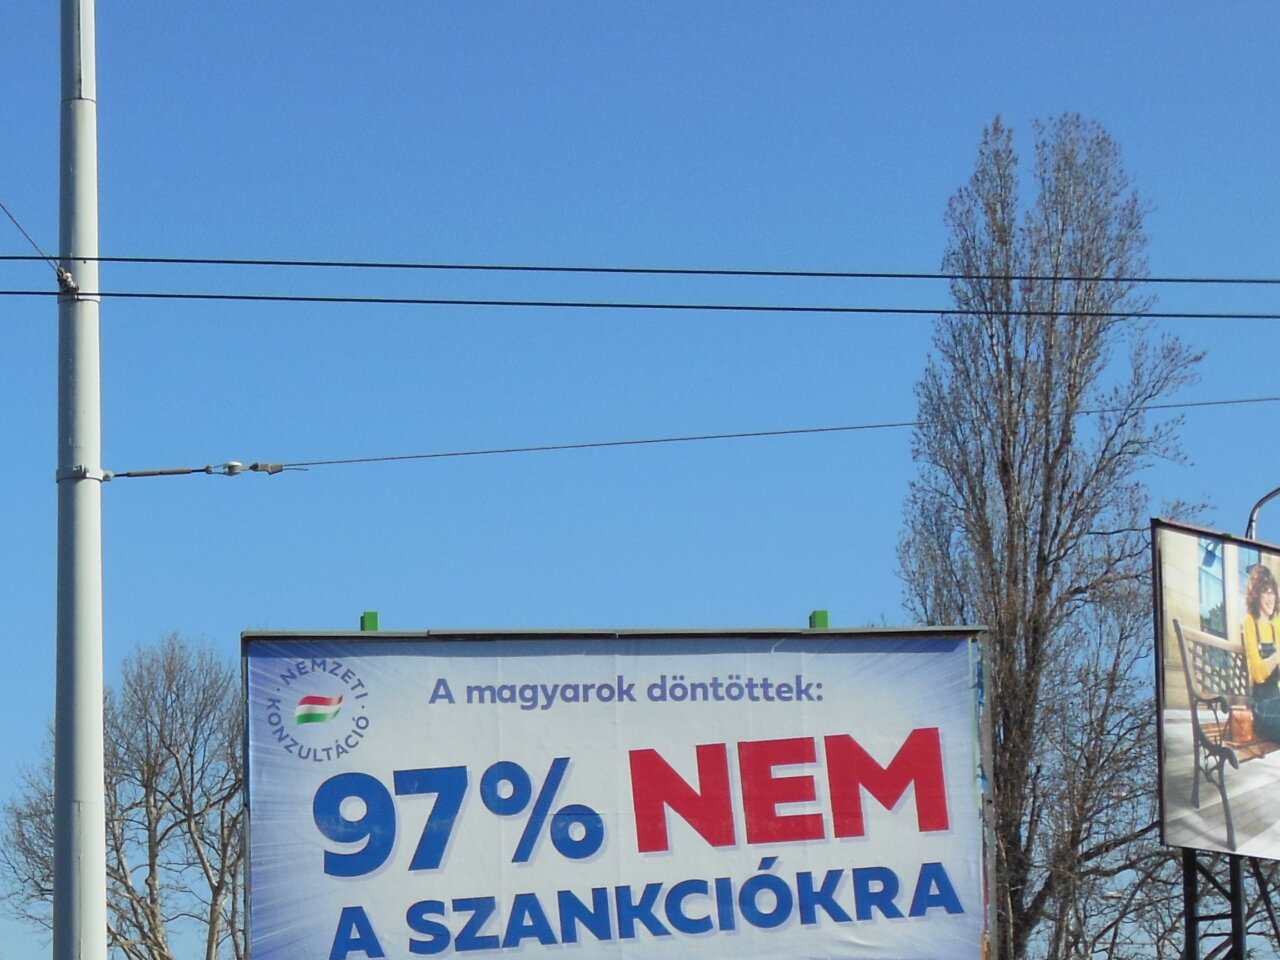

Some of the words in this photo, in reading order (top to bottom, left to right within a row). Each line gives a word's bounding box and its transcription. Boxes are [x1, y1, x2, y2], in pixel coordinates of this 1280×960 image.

[280, 658, 368, 699] NEMZETI
[428, 678, 456, 704] A
[466, 676, 637, 711] magyarok
[646, 674, 823, 702] döntöttek:
[266, 698, 370, 762] KONZULTÁCIÓ
[312, 757, 604, 877] 97%
[629, 727, 950, 853] NEM
[407, 856, 965, 955] SZANKCIÓKRA
